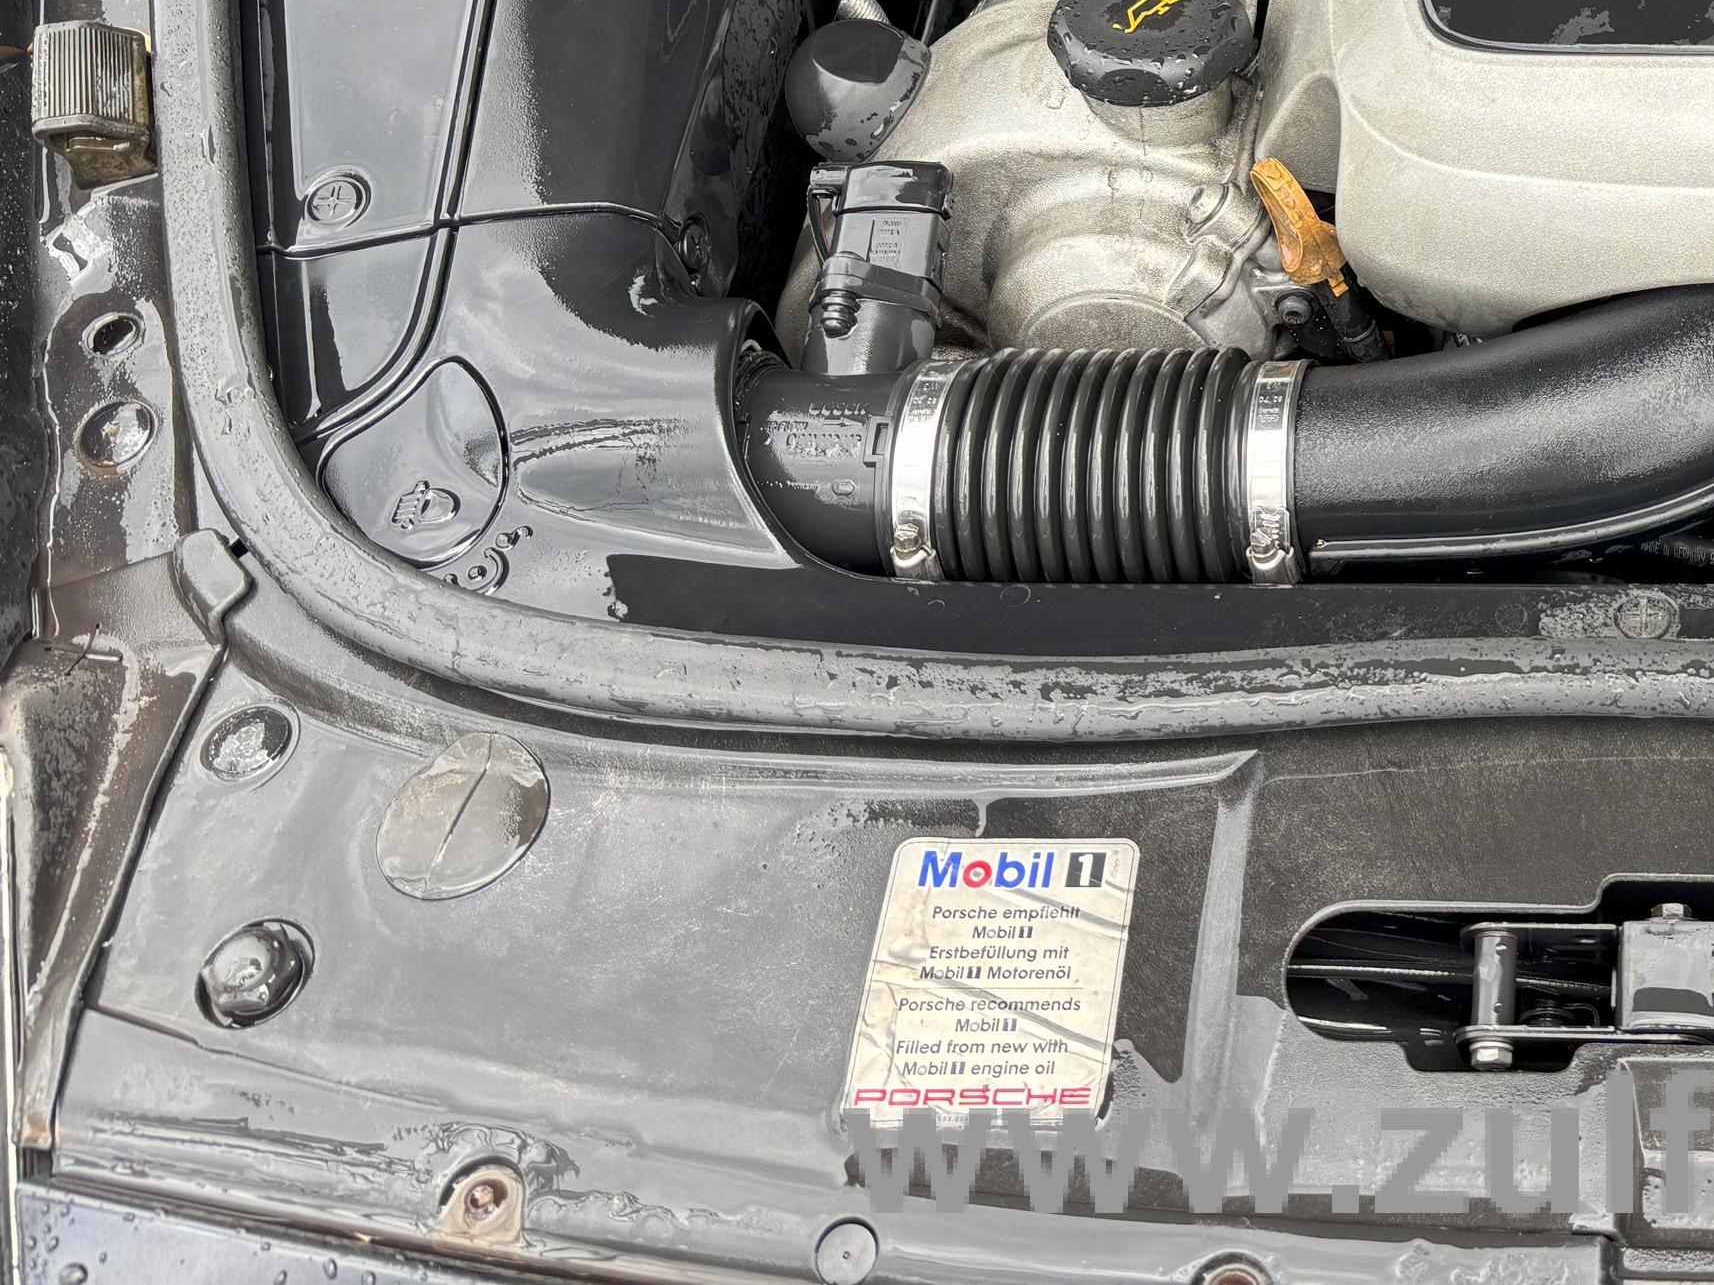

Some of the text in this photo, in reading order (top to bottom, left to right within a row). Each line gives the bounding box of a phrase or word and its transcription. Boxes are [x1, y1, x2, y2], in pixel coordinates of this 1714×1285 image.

[917, 850, 1055, 888] Mobil
[1069, 852, 1103, 887] 1
[932, 905, 1081, 922] Porsche empfiehlt
[972, 926, 1015, 939] Mobil
[929, 946, 1069, 962] Erstbefüllung mit
[920, 967, 964, 980] Mobil
[987, 966, 1071, 980] Motorenöl
[899, 998, 1081, 1011] Porsche recommends
[955, 1018, 999, 1031] Mobil
[896, 1040, 1068, 1054] Filled from new with
[902, 1062, 947, 1075] Mobil
[971, 1062, 1031, 1077] engine
[1035, 1061, 1055, 1074] oil
[854, 1088, 1092, 1106] PORSCHE
